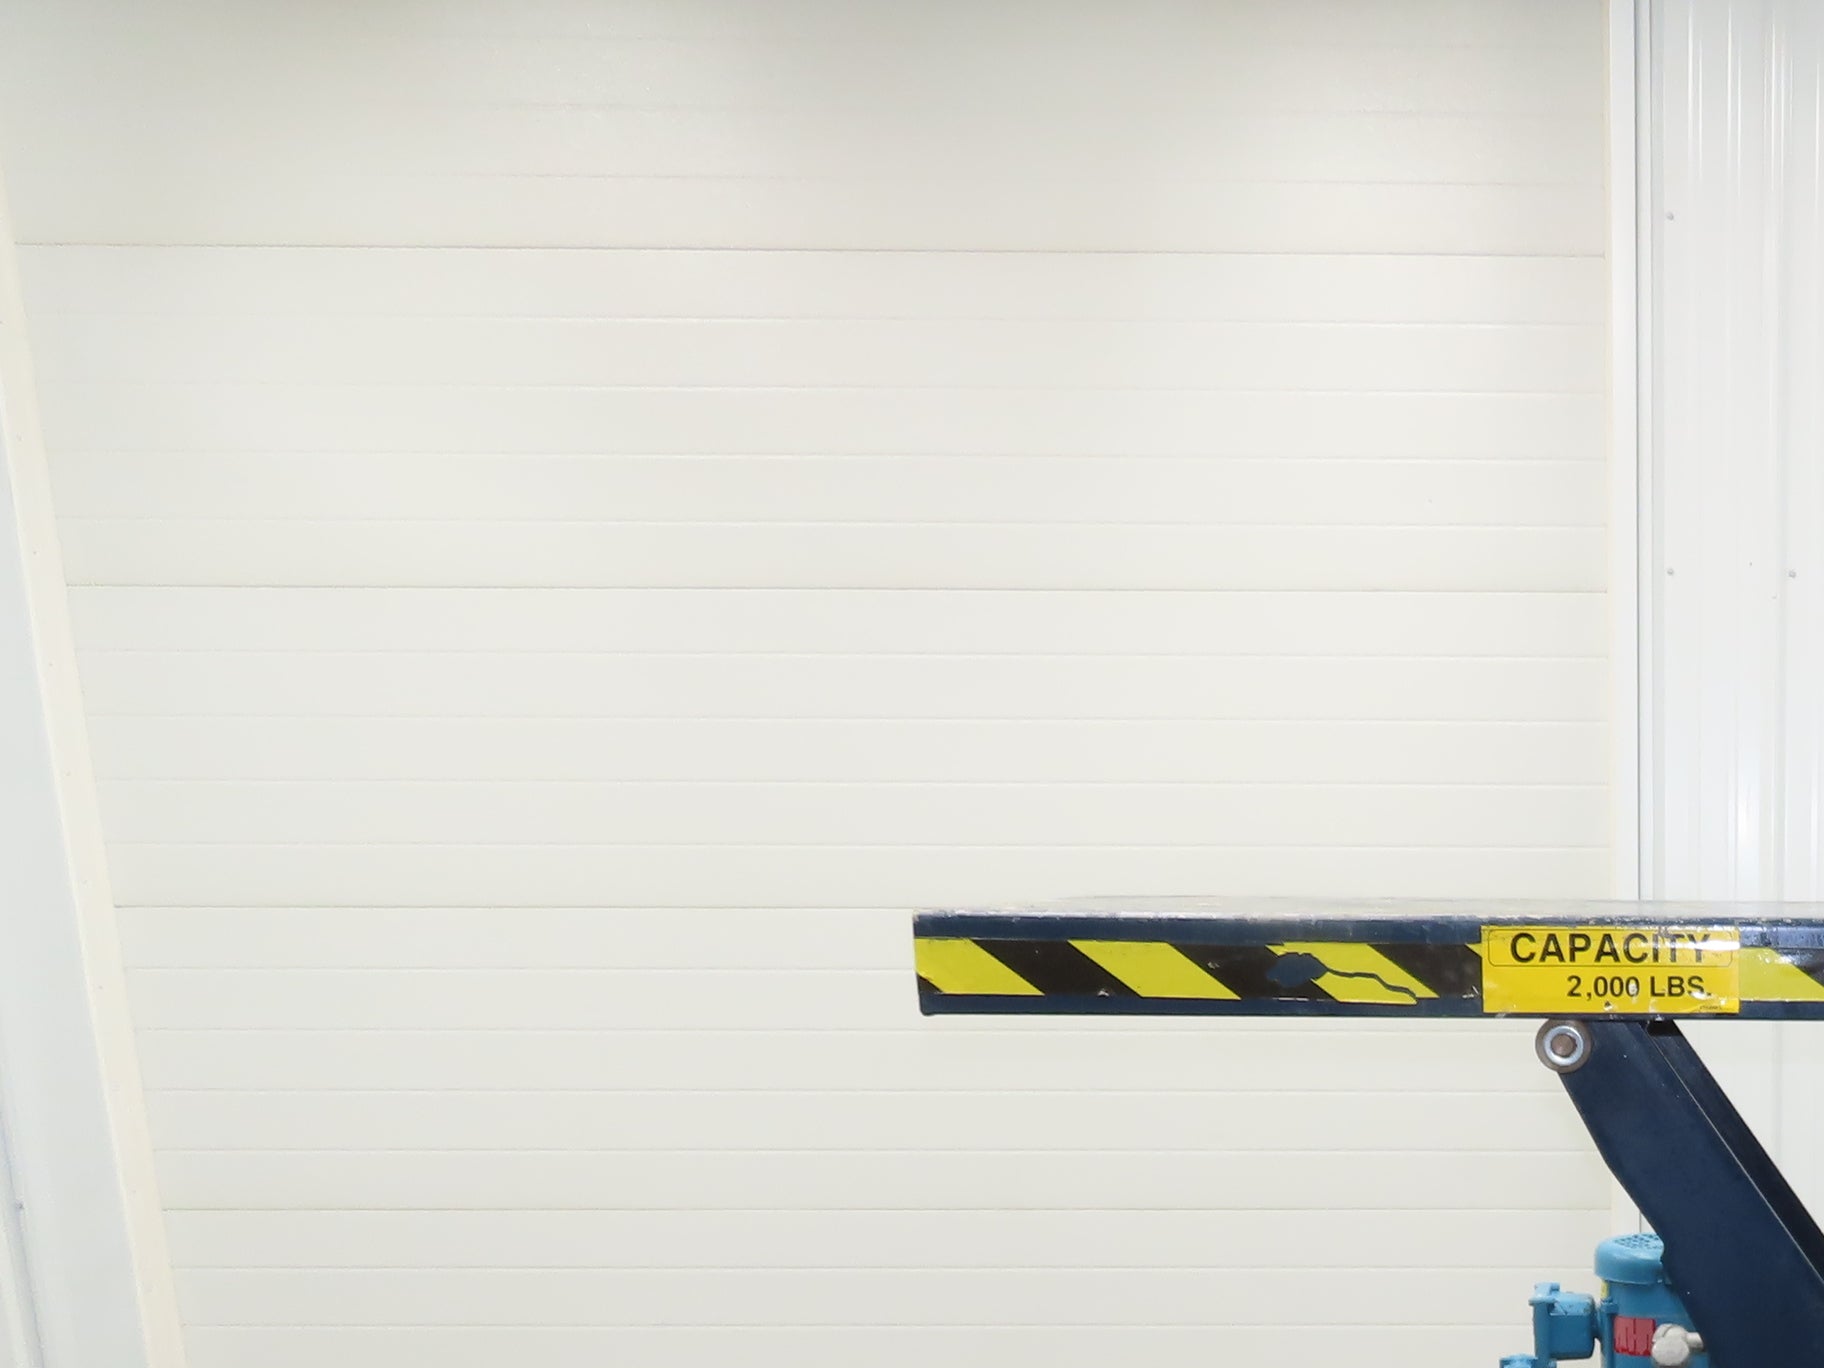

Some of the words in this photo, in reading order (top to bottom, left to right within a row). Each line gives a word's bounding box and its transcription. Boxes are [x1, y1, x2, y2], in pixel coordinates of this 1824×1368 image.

[1510, 932, 1711, 963] CAPACITY
[1567, 975, 1640, 1000] 2,000
[1650, 976, 1712, 997] LBS.
